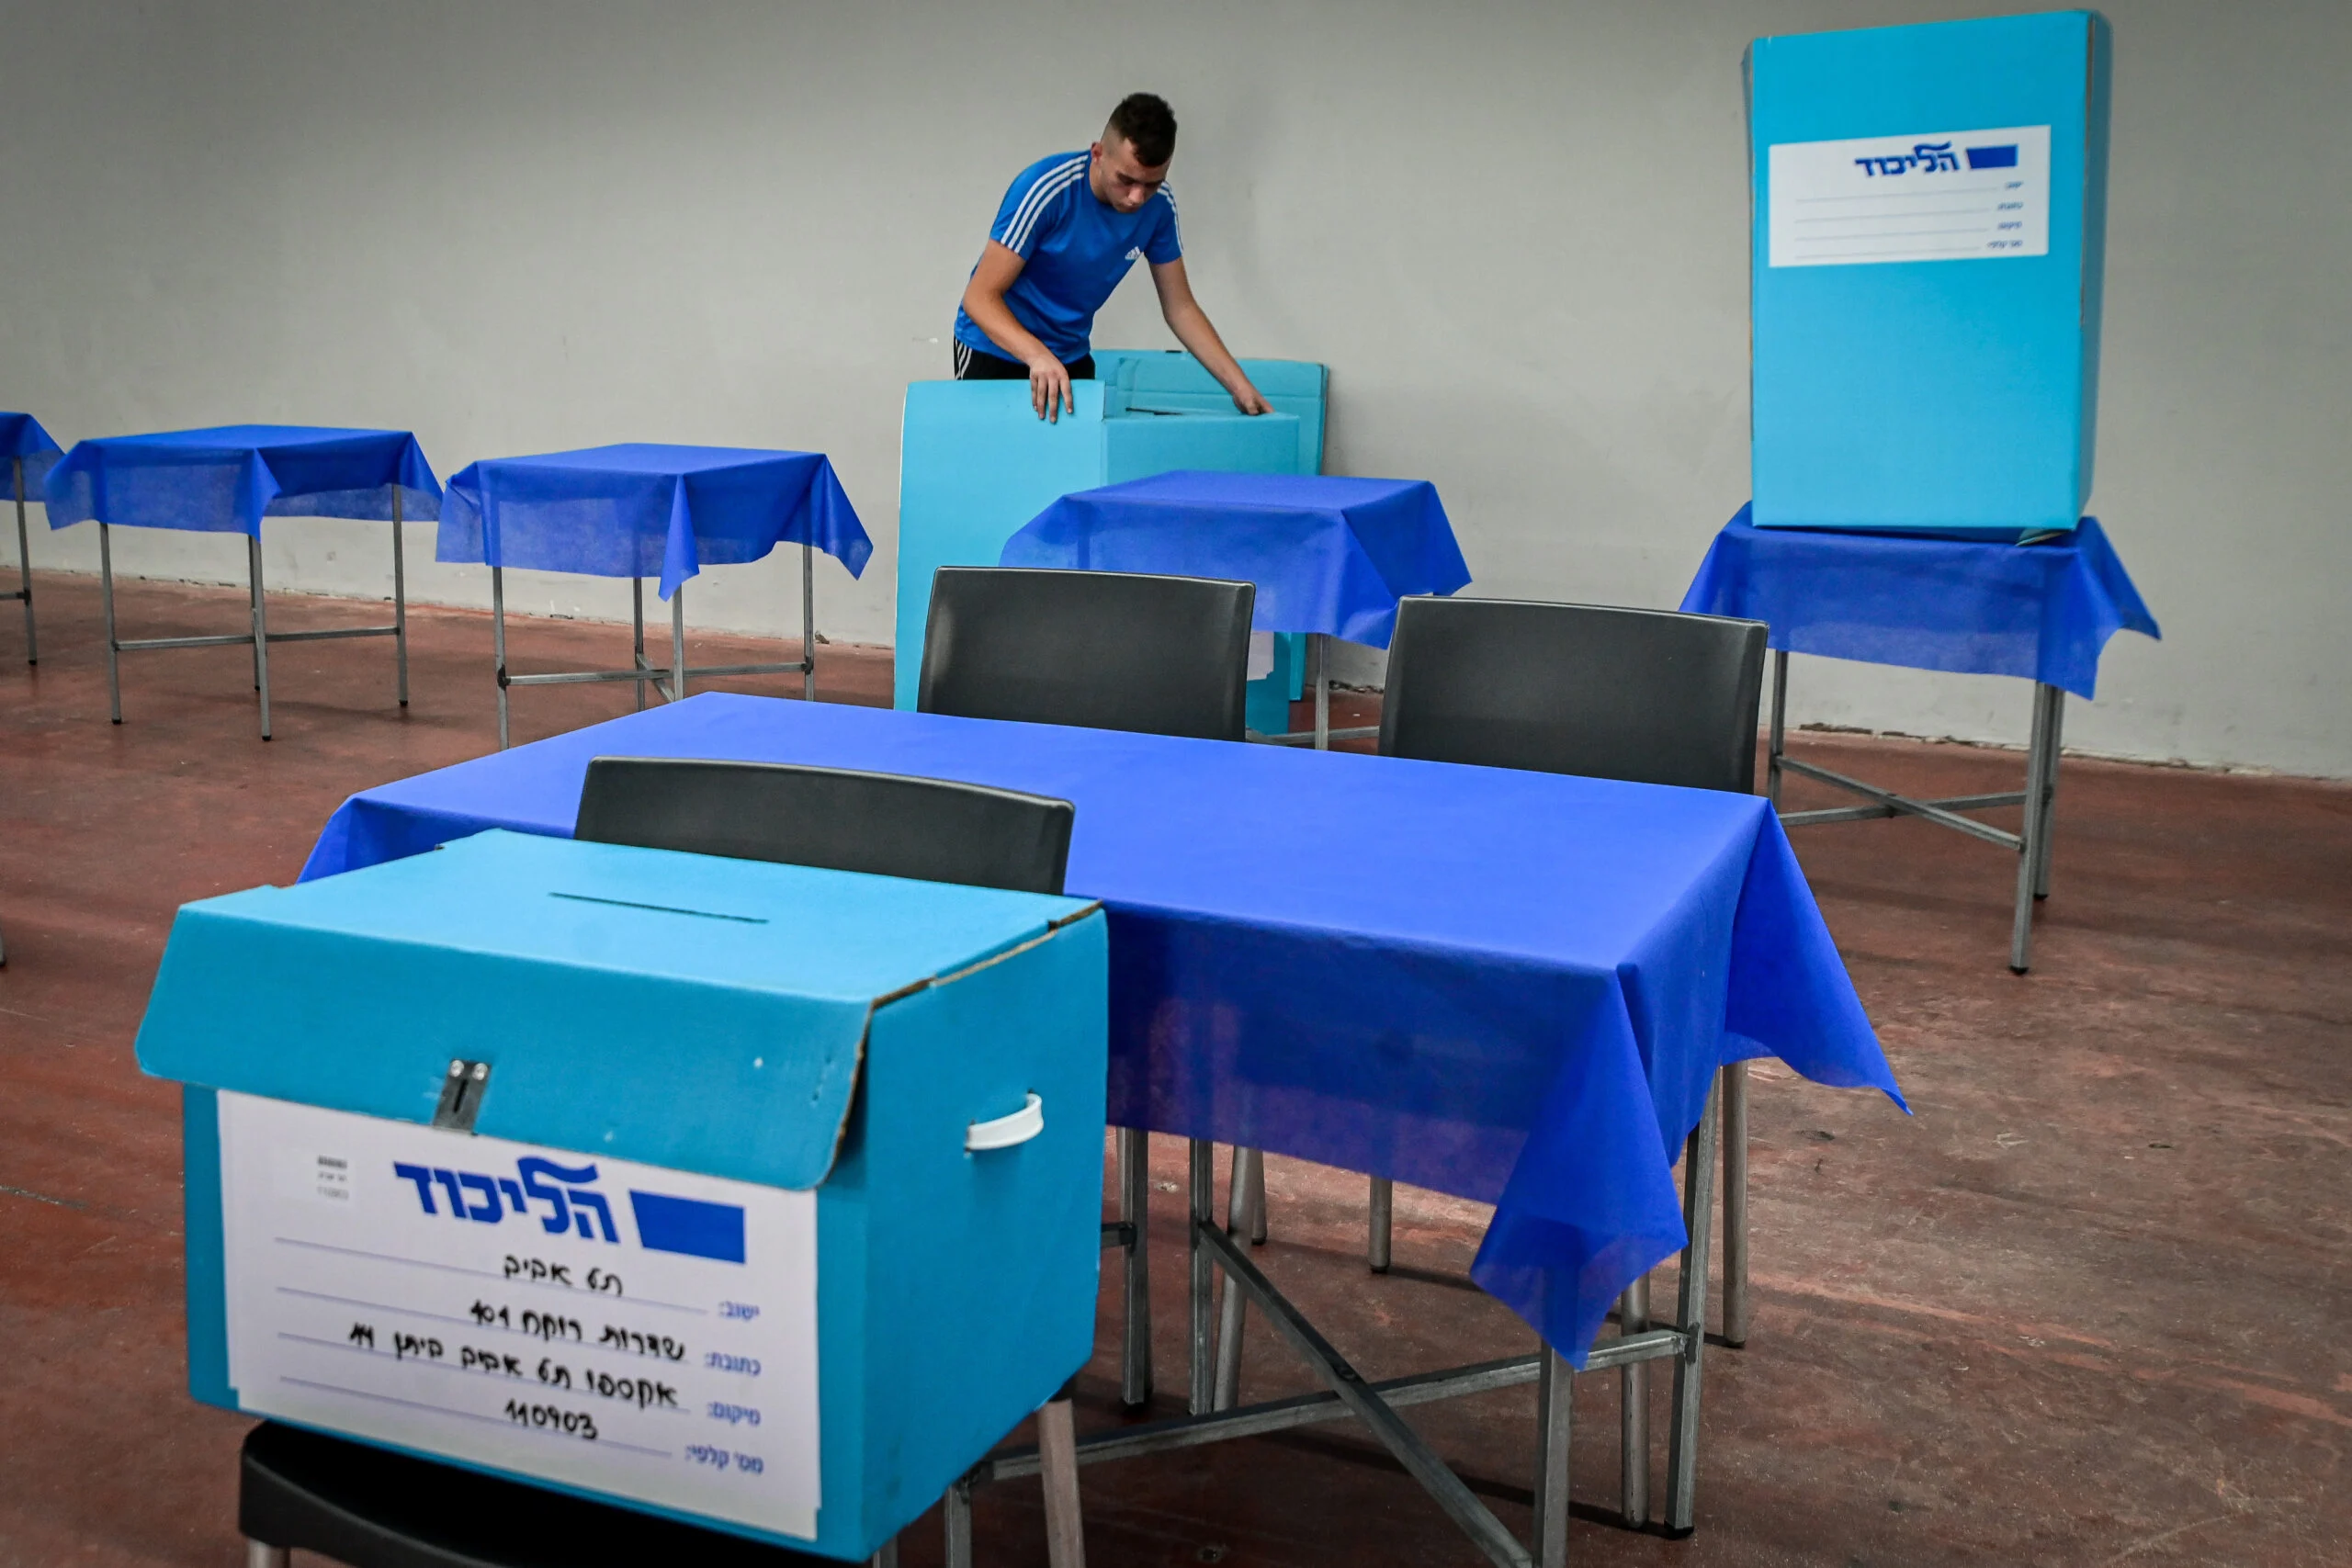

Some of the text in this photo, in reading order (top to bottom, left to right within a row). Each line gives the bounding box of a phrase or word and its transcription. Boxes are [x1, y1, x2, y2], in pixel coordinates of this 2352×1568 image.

[1854, 141, 1960, 176] הליכוד
[393, 1155, 620, 1244] הליכוד
[503, 1254, 623, 1297] תל אביב
[521, 1309, 582, 1341] רוקח
[599, 1324, 684, 1360] שדרות
[537, 1358, 571, 1390] תל
[505, 1398, 597, 1440] 110903
